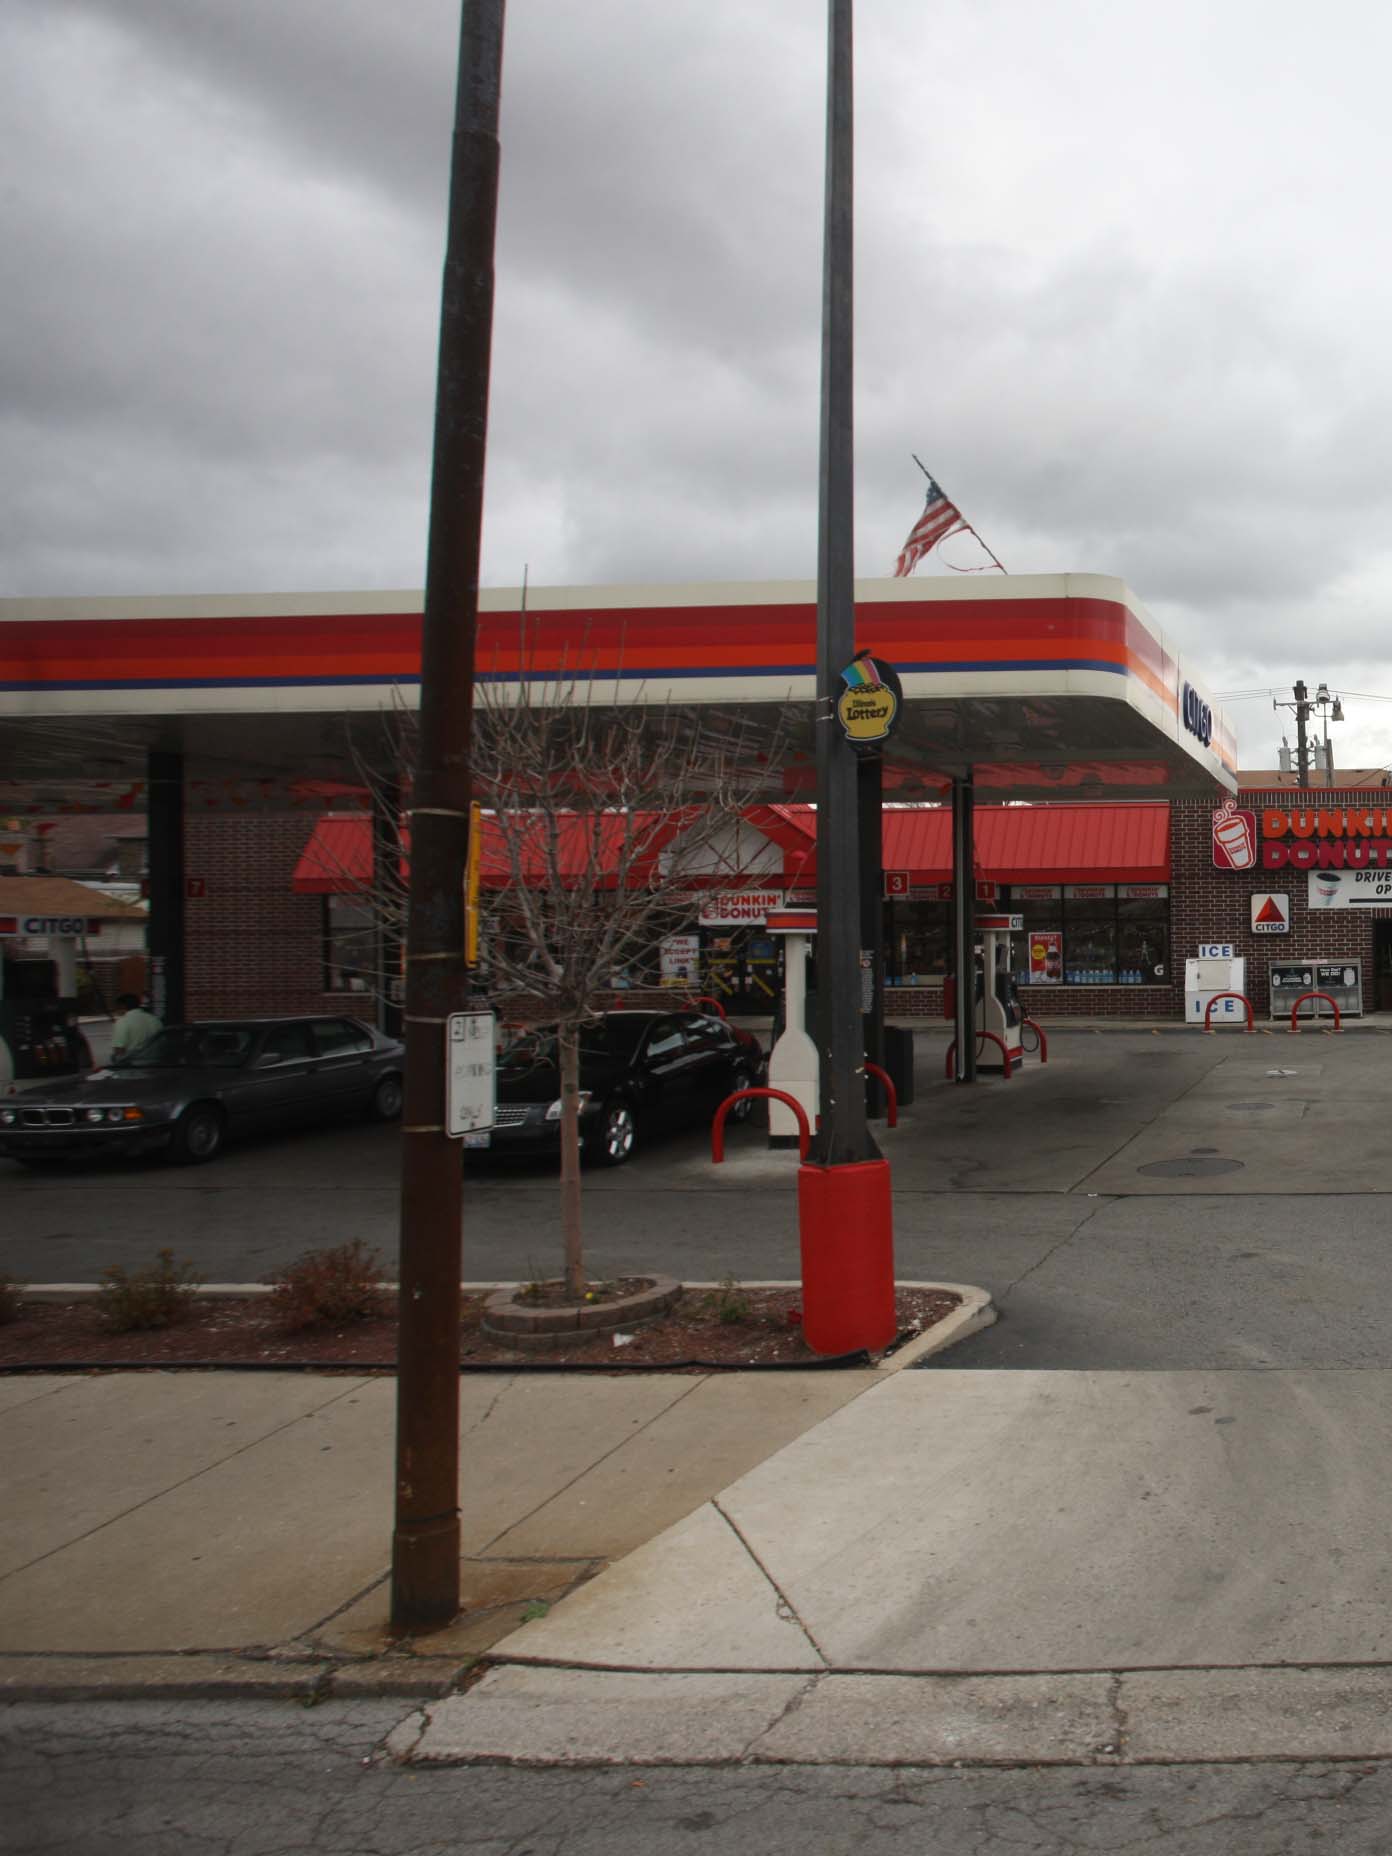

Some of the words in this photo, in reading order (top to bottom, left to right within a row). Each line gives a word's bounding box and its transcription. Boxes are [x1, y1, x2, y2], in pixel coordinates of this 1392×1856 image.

[846, 706, 889, 720] Lottery
[893, 876, 903, 890] 3
[25, 918, 83, 934] CITGO
[1255, 923, 1286, 932] CITGO
[1202, 946, 1231, 957] ICE
[1153, 964, 1165, 976] G
[1195, 1000, 1235, 1013] ICE
